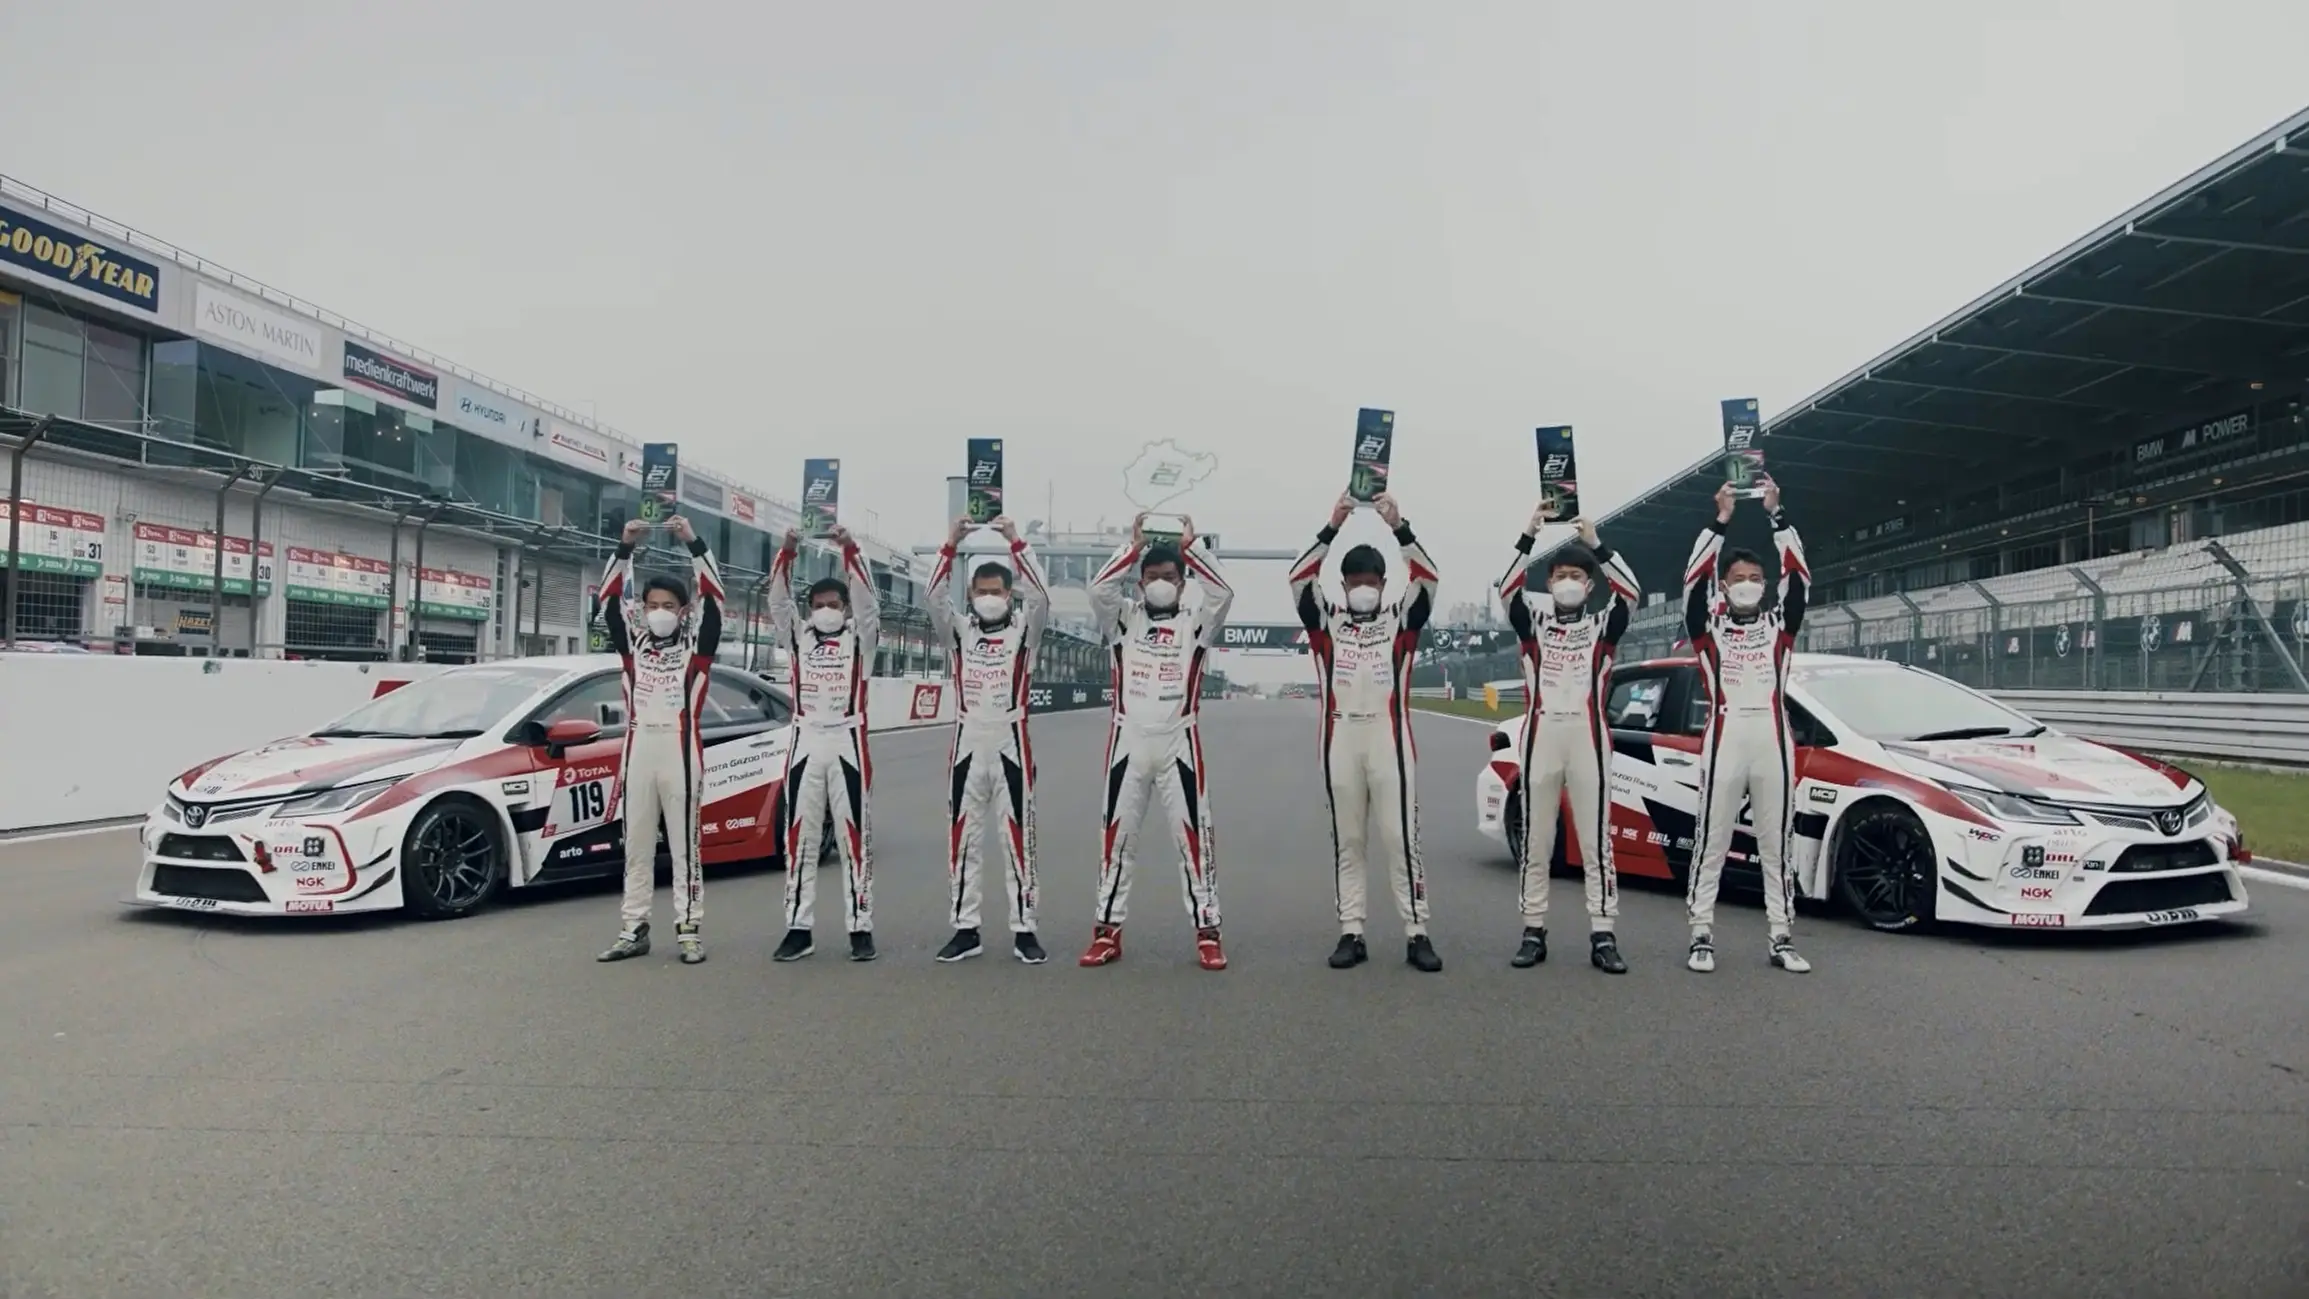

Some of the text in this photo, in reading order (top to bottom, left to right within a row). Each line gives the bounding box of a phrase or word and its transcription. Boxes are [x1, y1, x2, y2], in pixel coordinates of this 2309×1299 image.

[205, 301, 314, 357] ASTON MARTIN
[346, 353, 437, 399] medienkraftwerk
[473, 404, 506, 426] HYUNDAI
[2137, 438, 2164, 462] BMW
[2203, 414, 2248, 442] POWER
[88, 543, 102, 559] 31
[259, 566, 271, 580] 30
[1224, 628, 1268, 643] BMW
[1342, 648, 1382, 661] TOYOTA
[1547, 650, 1585, 662] TOYOTA
[1728, 650, 1767, 662] TOYOTA
[641, 672, 678, 685] TOYOTA
[806, 671, 845, 681] TOYOTA
[968, 668, 1008, 680] TOYOTA
[578, 765, 612, 778] TOTAL
[703, 763, 728, 775] YOTA
[708, 768, 764, 789] Team Thailand
[504, 782, 527, 792] MCS
[1811, 788, 1836, 799] MCS
[569, 781, 605, 823] 119
[559, 846, 583, 859] arto
[312, 861, 335, 871] ENKEI
[2033, 868, 2060, 880] ENKEI
[296, 877, 325, 887] NGK
[2021, 888, 2052, 898] NGK
[287, 900, 331, 911] MOTUL
[2014, 914, 2062, 926] MOTUL
